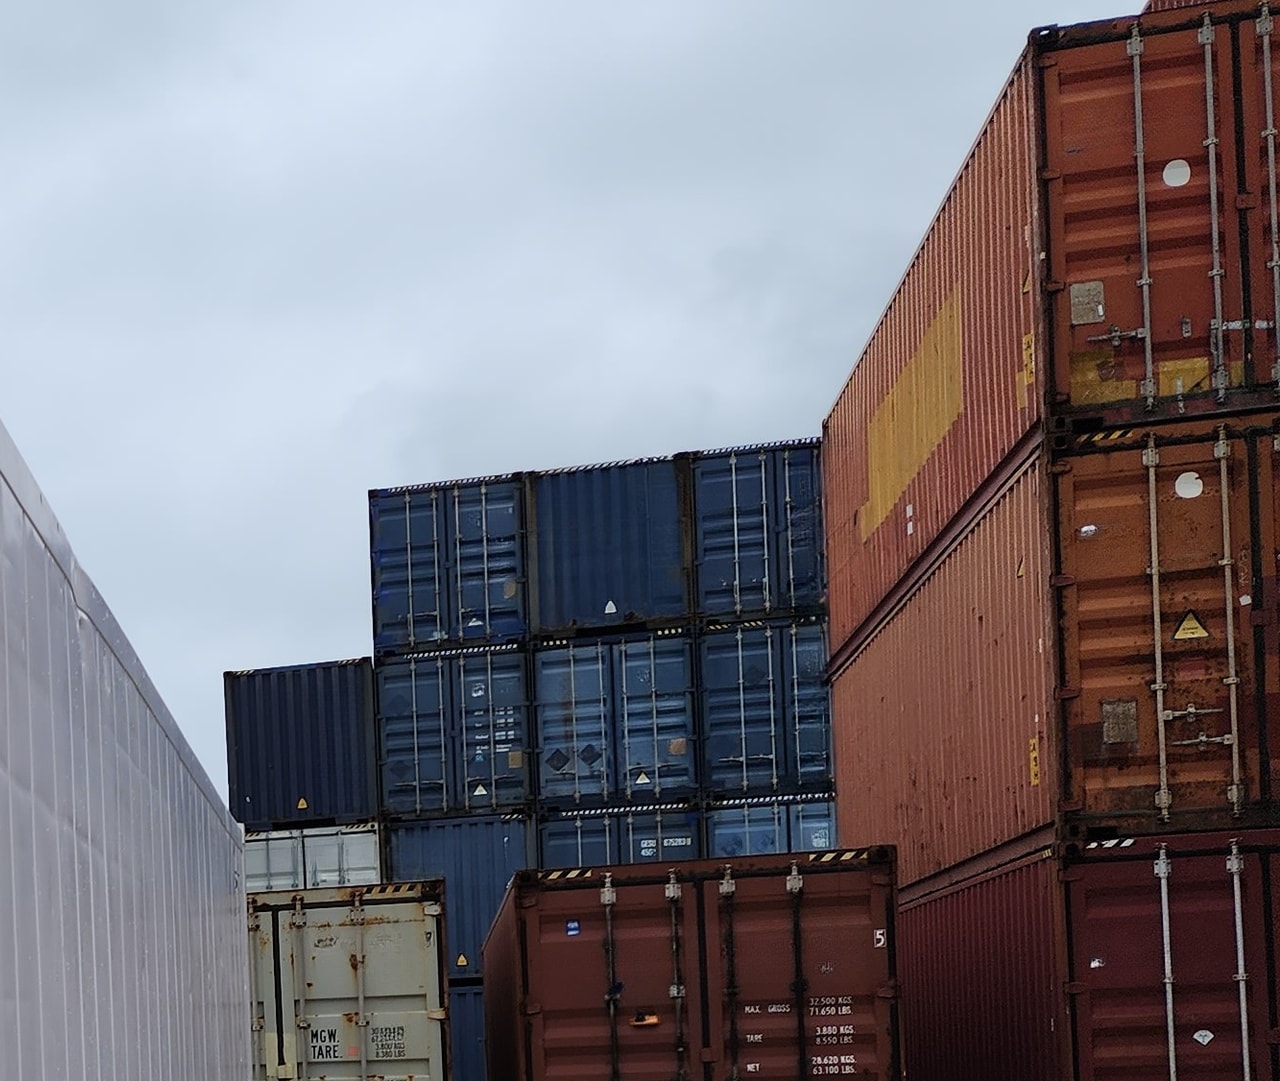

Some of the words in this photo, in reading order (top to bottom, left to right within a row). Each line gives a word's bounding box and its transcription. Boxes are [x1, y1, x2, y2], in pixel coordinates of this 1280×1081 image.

[876, 930, 885, 946] 5
[767, 1004, 791, 1013] GROSS
[746, 1034, 763, 1042] TARE
[747, 1063, 760, 1072] NET
